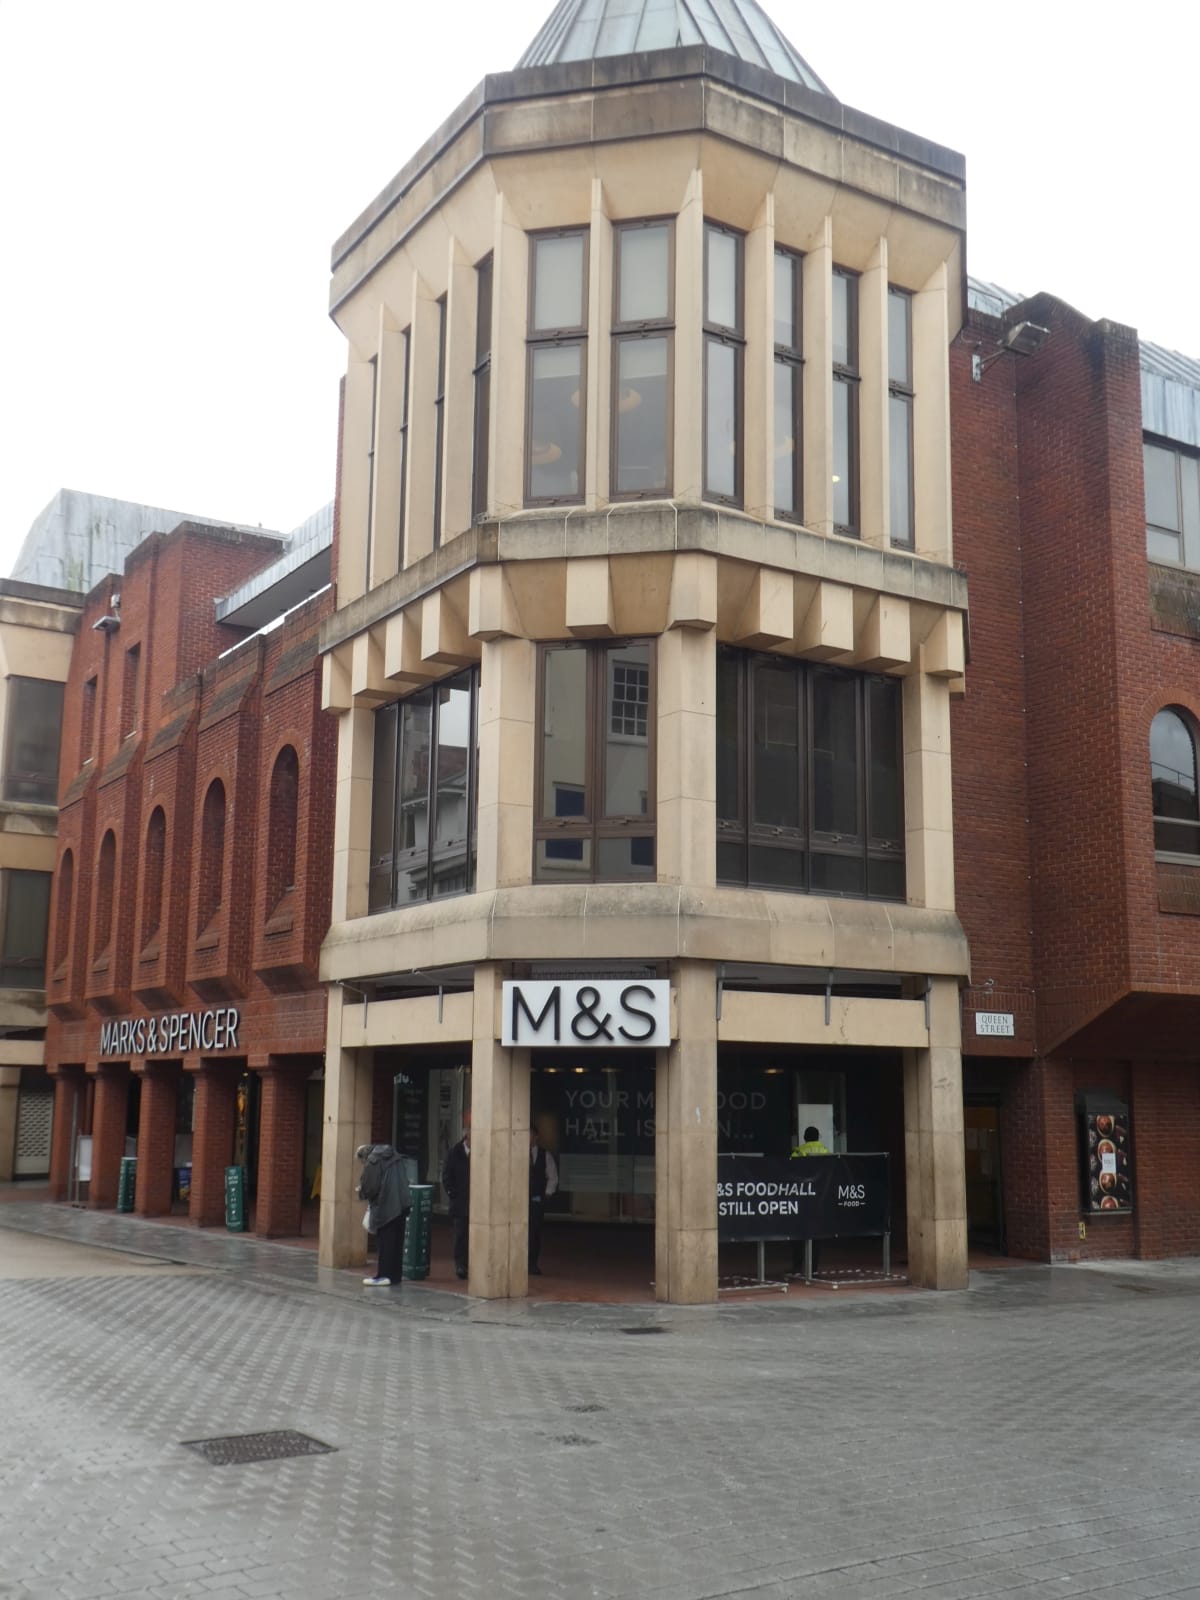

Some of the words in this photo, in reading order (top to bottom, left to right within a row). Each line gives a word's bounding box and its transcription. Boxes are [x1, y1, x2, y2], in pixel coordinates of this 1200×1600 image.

[511, 984, 657, 1042] M&S
[981, 1014, 1008, 1025] QUEEN
[980, 1024, 1009, 1034] STREET
[564, 1089, 630, 1109] YOUR
[564, 1118, 626, 1137] HALL
[717, 1183, 734, 1197] &S
[737, 1182, 816, 1197] FOODHALL
[838, 1184, 866, 1200] M&S
[718, 1201, 755, 1216] STILL
[758, 1200, 799, 1215] OPEN
